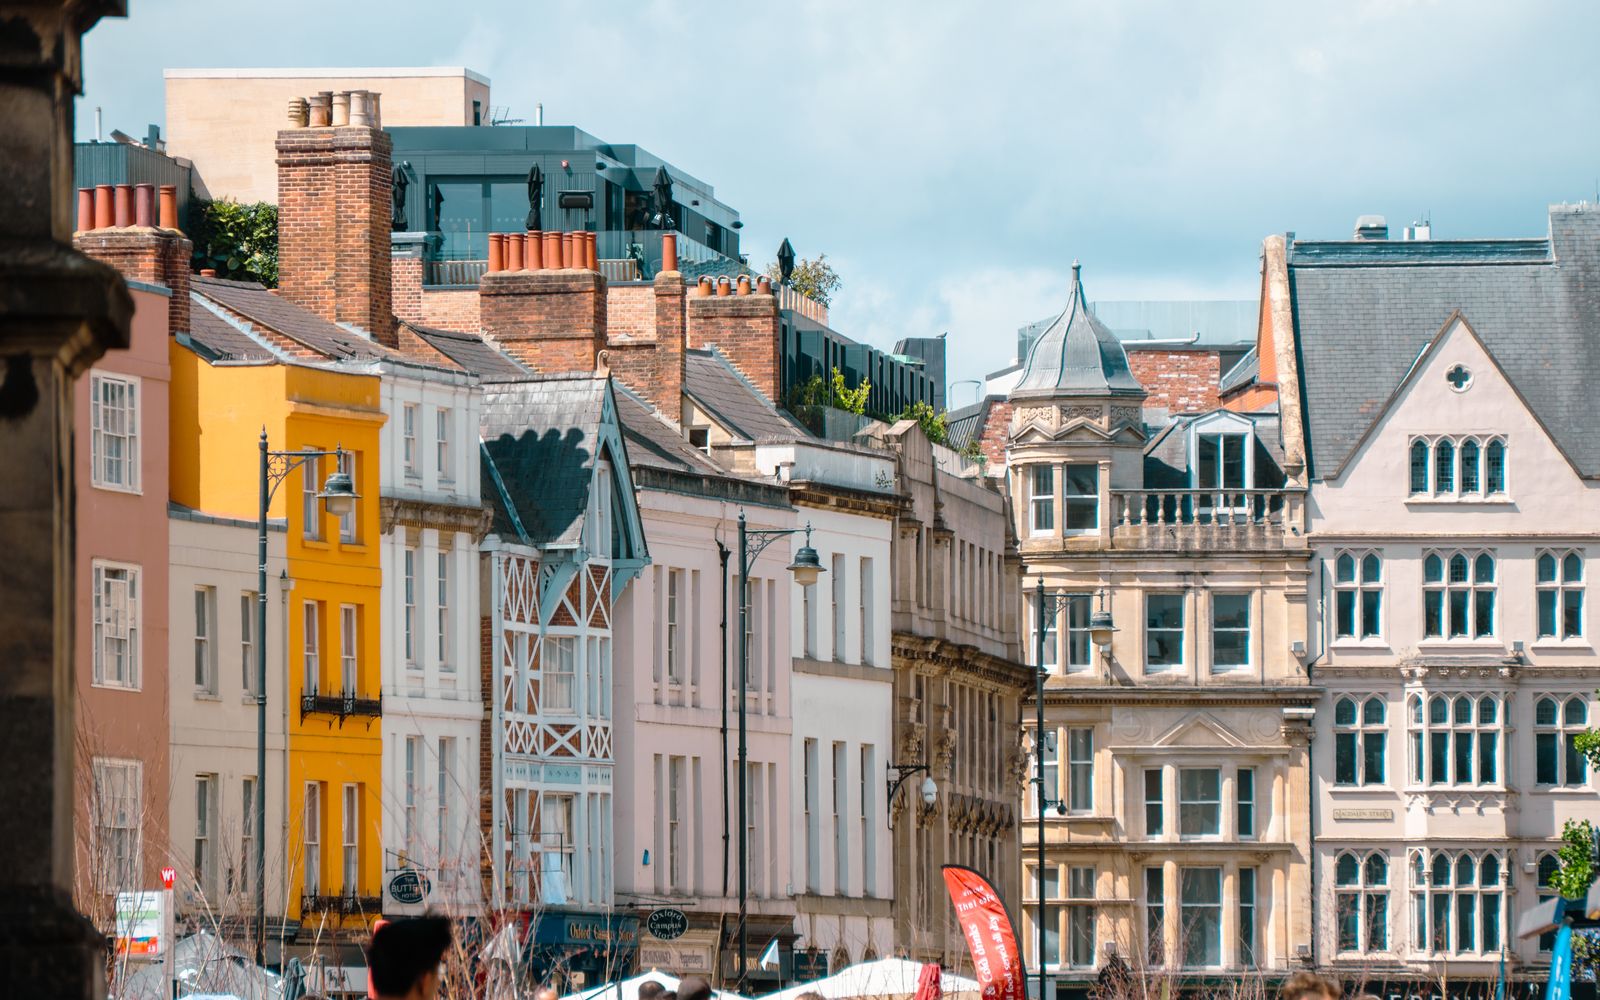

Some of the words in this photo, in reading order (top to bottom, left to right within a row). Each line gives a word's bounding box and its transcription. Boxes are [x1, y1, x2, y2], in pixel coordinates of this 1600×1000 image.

[651, 909, 683, 921] Oxford
[650, 922, 682, 930] Campus
[968, 923, 986, 955] drinks
[977, 957, 993, 982] Cold
